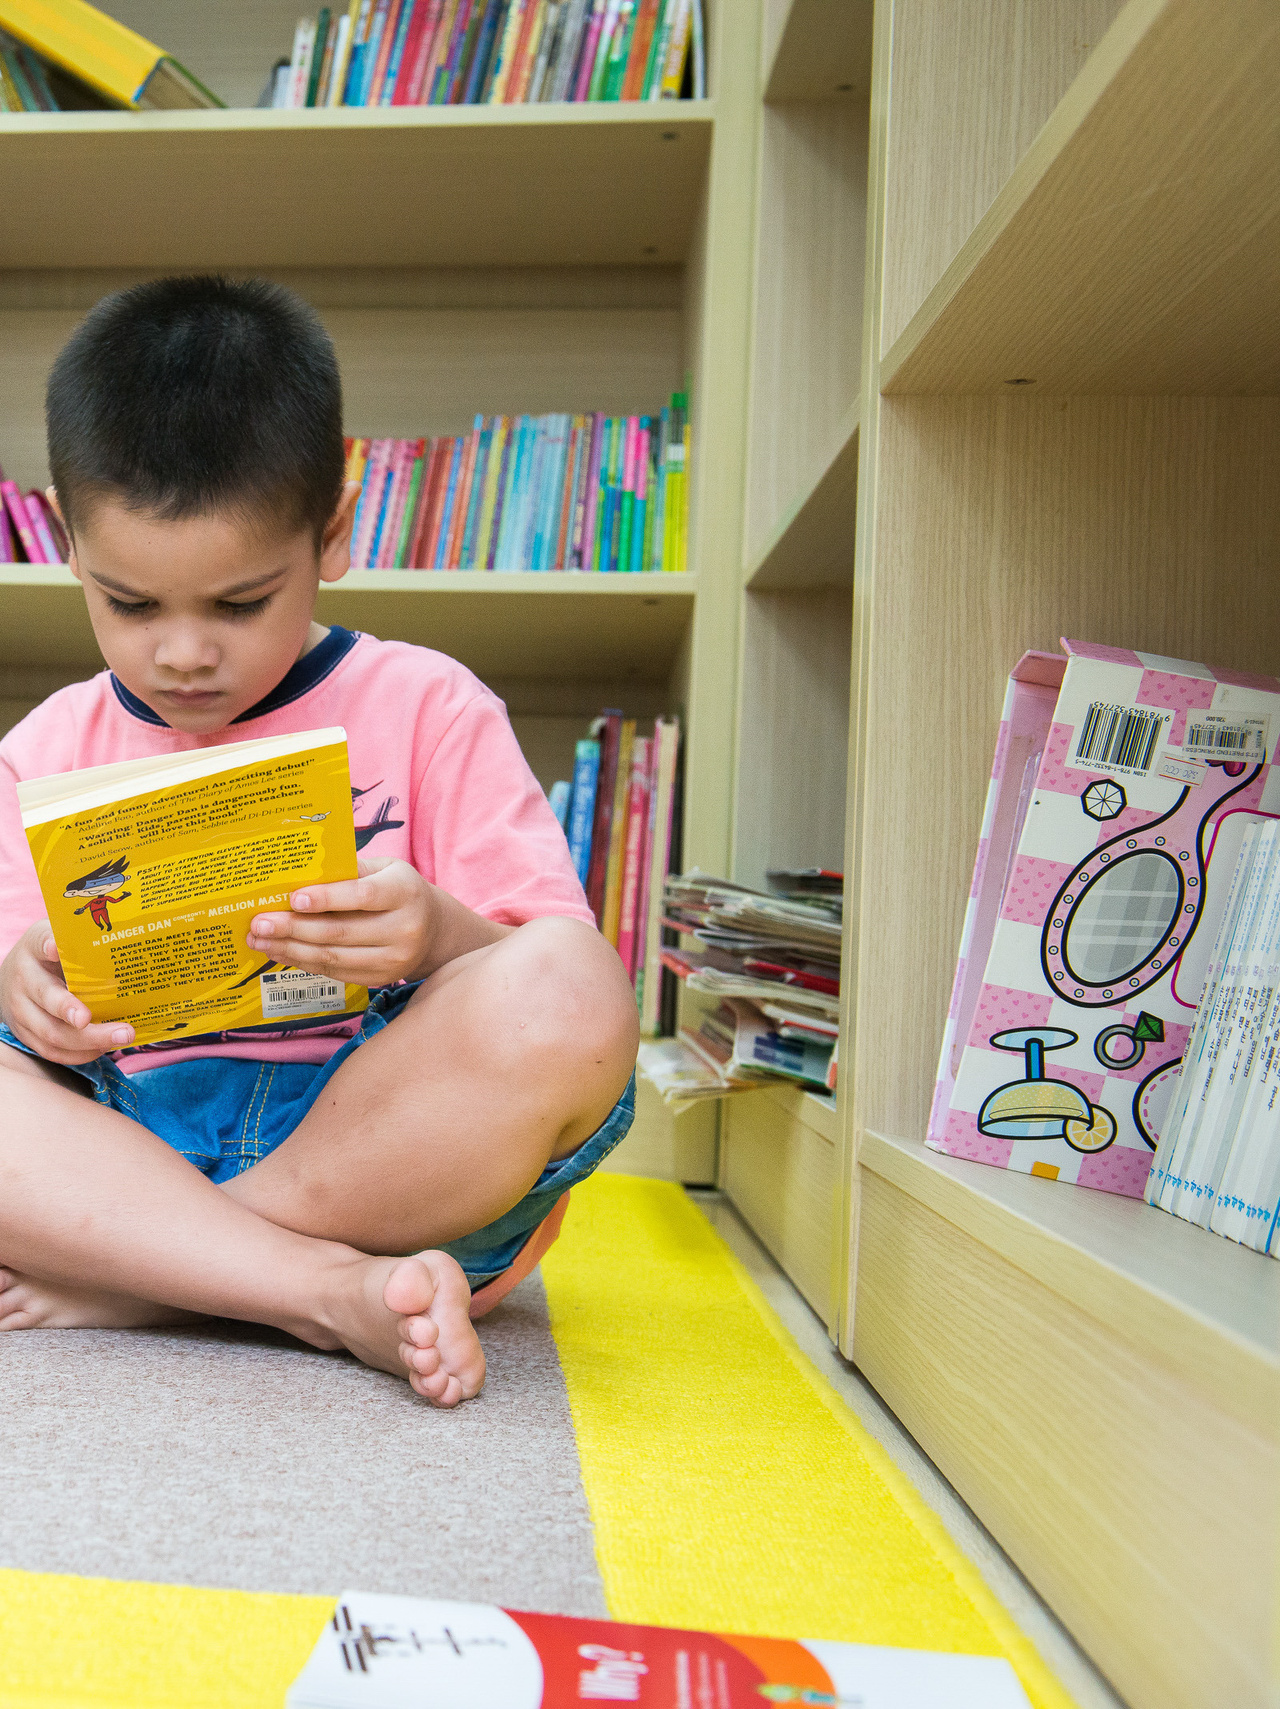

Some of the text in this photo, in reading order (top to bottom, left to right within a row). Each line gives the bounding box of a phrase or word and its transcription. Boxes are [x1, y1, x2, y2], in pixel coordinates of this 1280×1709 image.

[1093, 701, 1126, 714] 327745
[1128, 707, 1160, 721] 781843
[1132, 770, 1147, 778] ISBN
[74, 819, 93, 827] fun
[95, 811, 115, 821] and
[117, 803, 149, 815] funny
[152, 785, 209, 805] adventure!
[229, 770, 273, 784] exciting
[136, 813, 174, 827] Danger
[177, 807, 198, 816] Dan
[212, 787, 277, 807] dangerously
[279, 783, 301, 791] fun.
[88, 836, 113, 847] solid
[115, 832, 134, 840] hit.
[137, 824, 164, 834] Kids,
[166, 812, 207, 827] parents
[210, 804, 229, 814] and
[232, 799, 257, 809] even
[259, 790, 305, 802] teachers
[139, 808, 243, 839] will love this book!"
[101, 925, 146, 944] DANGER
[148, 918, 173, 932] DAN
[172, 910, 206, 922] CONFRONTS
[208, 900, 255, 917] MERLION
[258, 892, 292, 907] MAST
[110, 942, 143, 953] DANGER
[145, 937, 163, 945] DAN
[165, 931, 191, 940] MEETS
[120, 942, 170, 957] MYSTERIOUS
[193, 933, 216, 942] FROM
[149, 949, 169, 958] THEY
[172, 945, 194, 953] HAVE
[210, 937, 232, 945] RACE
[114, 961, 149, 972] AGAINST
[152, 956, 170, 964] TIME
[187, 947, 217, 957] ENSURE
[114, 968, 148, 979] MERLION
[150, 960, 182, 971] DOESN'T
[217, 950, 237, 958] WITH
[119, 973, 154, 984] ORCHIDS
[157, 966, 191, 977] AROUND
[209, 957, 234, 966] HEAD!
[117, 981, 149, 992] SOUNDS
[151, 975, 177, 984] EASY?
[179, 971, 195, 979] NOT
[198, 967, 220, 975] WHEN
[149, 983, 171, 991] ODDS
